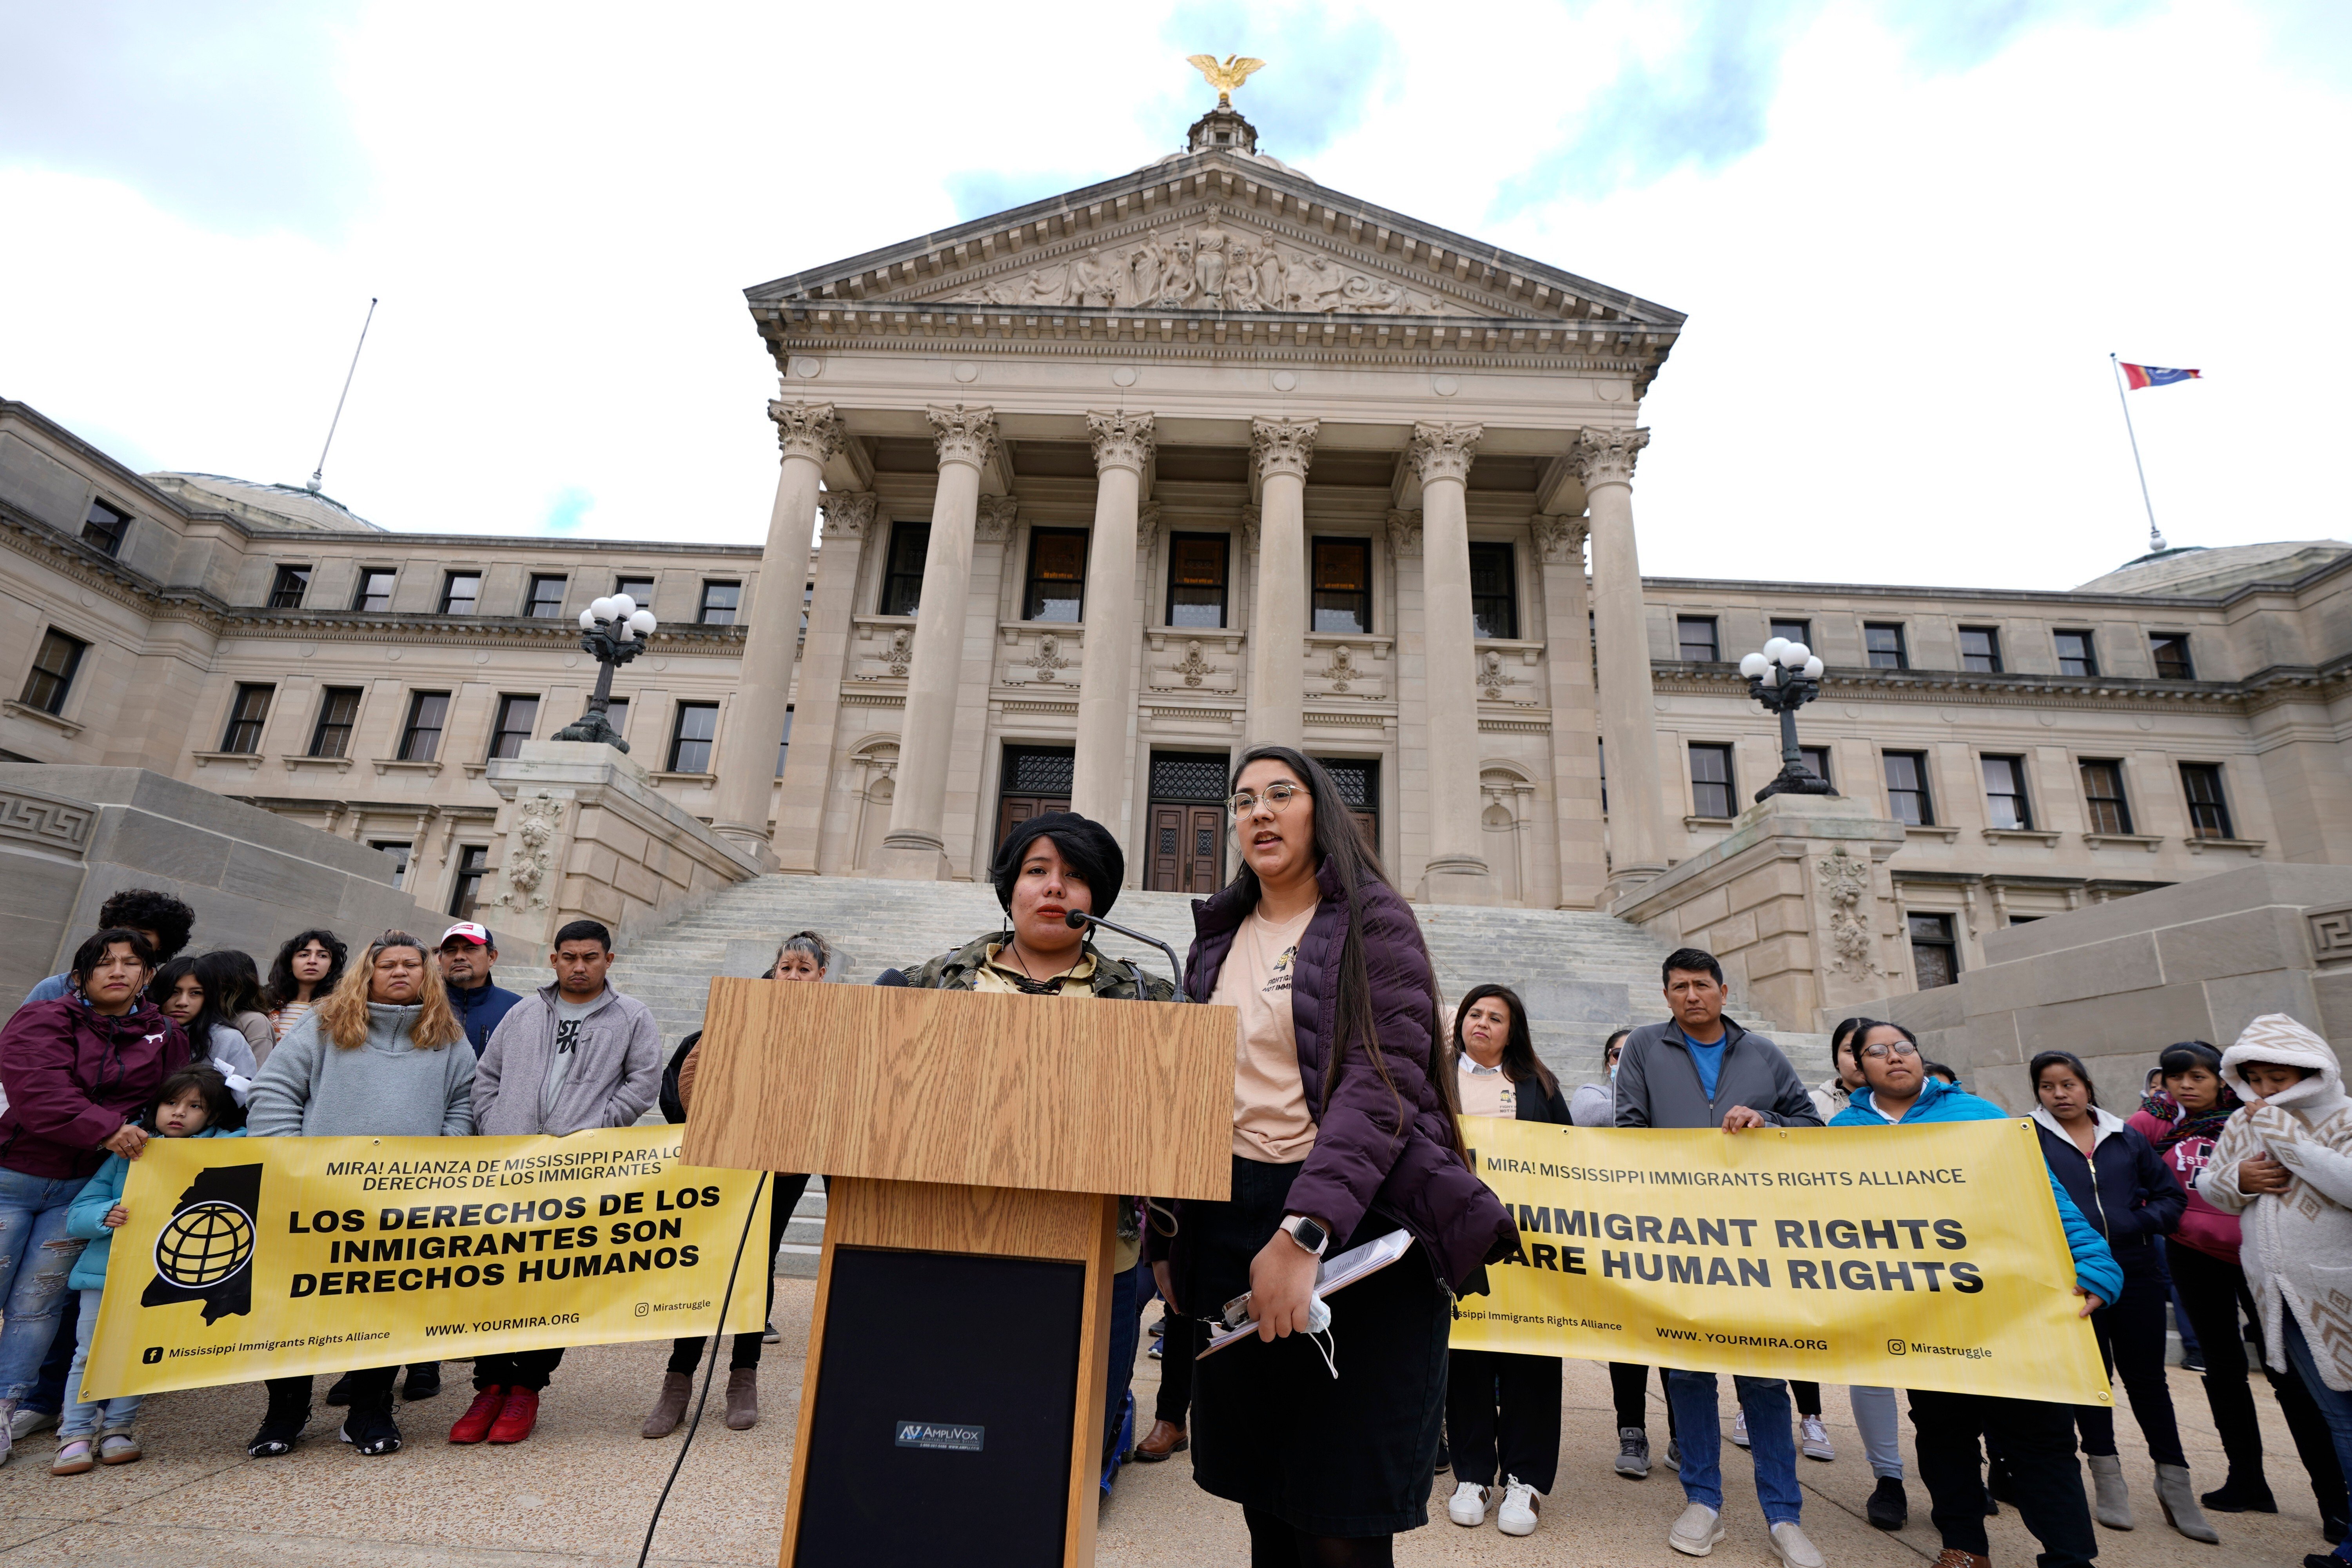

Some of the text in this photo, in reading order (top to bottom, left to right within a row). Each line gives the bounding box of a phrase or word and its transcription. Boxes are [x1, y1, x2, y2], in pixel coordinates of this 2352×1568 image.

[1267, 976, 1283, 986] FIGHT
[327, 1146, 682, 1175] MIRA! ALIANZA DE MISSISSIPPI PARA LO
[1488, 1158, 1965, 1185] MIRA! MISSISSIPPI IMMIGRANTS RIGHTS ALLIANCE
[363, 1162, 661, 1190] DERECHOS DE LOS IMMIGRANTES
[289, 1186, 719, 1233] LOS DERECHOS DE LOS
[330, 1218, 681, 1263] INMIGRANTES SON
[1775, 1219, 1966, 1250] RIGHTS
[290, 1245, 699, 1298] DERECHOS HUMANOS
[1503, 1243, 1984, 1293] ARE HUMAN RIGHTS
[654, 1300, 710, 1312] Mirastruggle
[426, 1313, 579, 1336] WWW. YOURMIRA.ORG
[1489, 1312, 1544, 1323] Immigrants
[1548, 1316, 1578, 1327] Rights
[1581, 1319, 1621, 1330] Alliance
[169, 1332, 390, 1357] Mississippi Immigrants Rights Alliance
[1656, 1328, 1827, 1350] WWW. YOURMIRA.ORG
[1911, 1343, 1991, 1359] Mirastruggle
